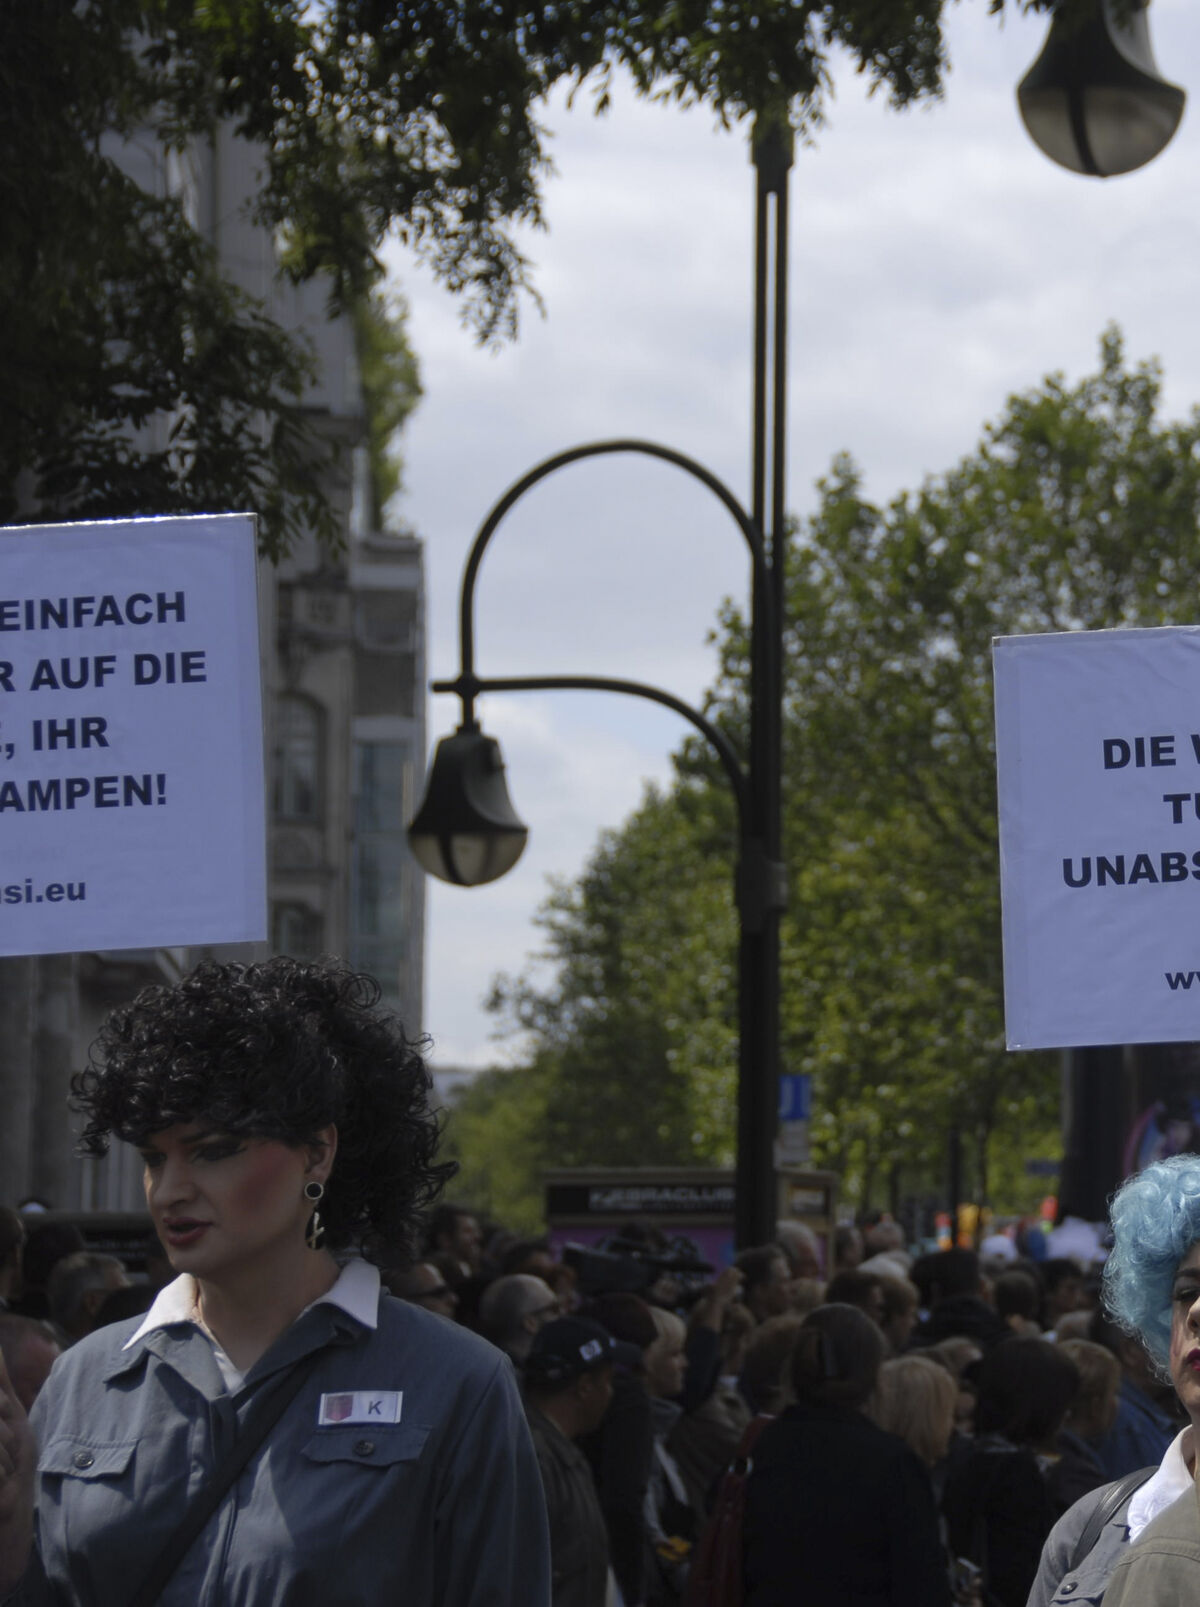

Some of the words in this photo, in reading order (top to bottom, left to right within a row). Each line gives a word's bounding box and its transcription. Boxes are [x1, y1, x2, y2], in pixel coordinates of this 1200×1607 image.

[0, 591, 186, 632] EINFACH
[29, 655, 117, 691] AUF
[134, 650, 207, 686] DIE
[32, 716, 110, 751] IHR
[1103, 735, 1177, 770] DIE
[0, 773, 166, 813] AMPEN!
[0, 878, 86, 905] si.eu
[367, 1400, 383, 1415] K
